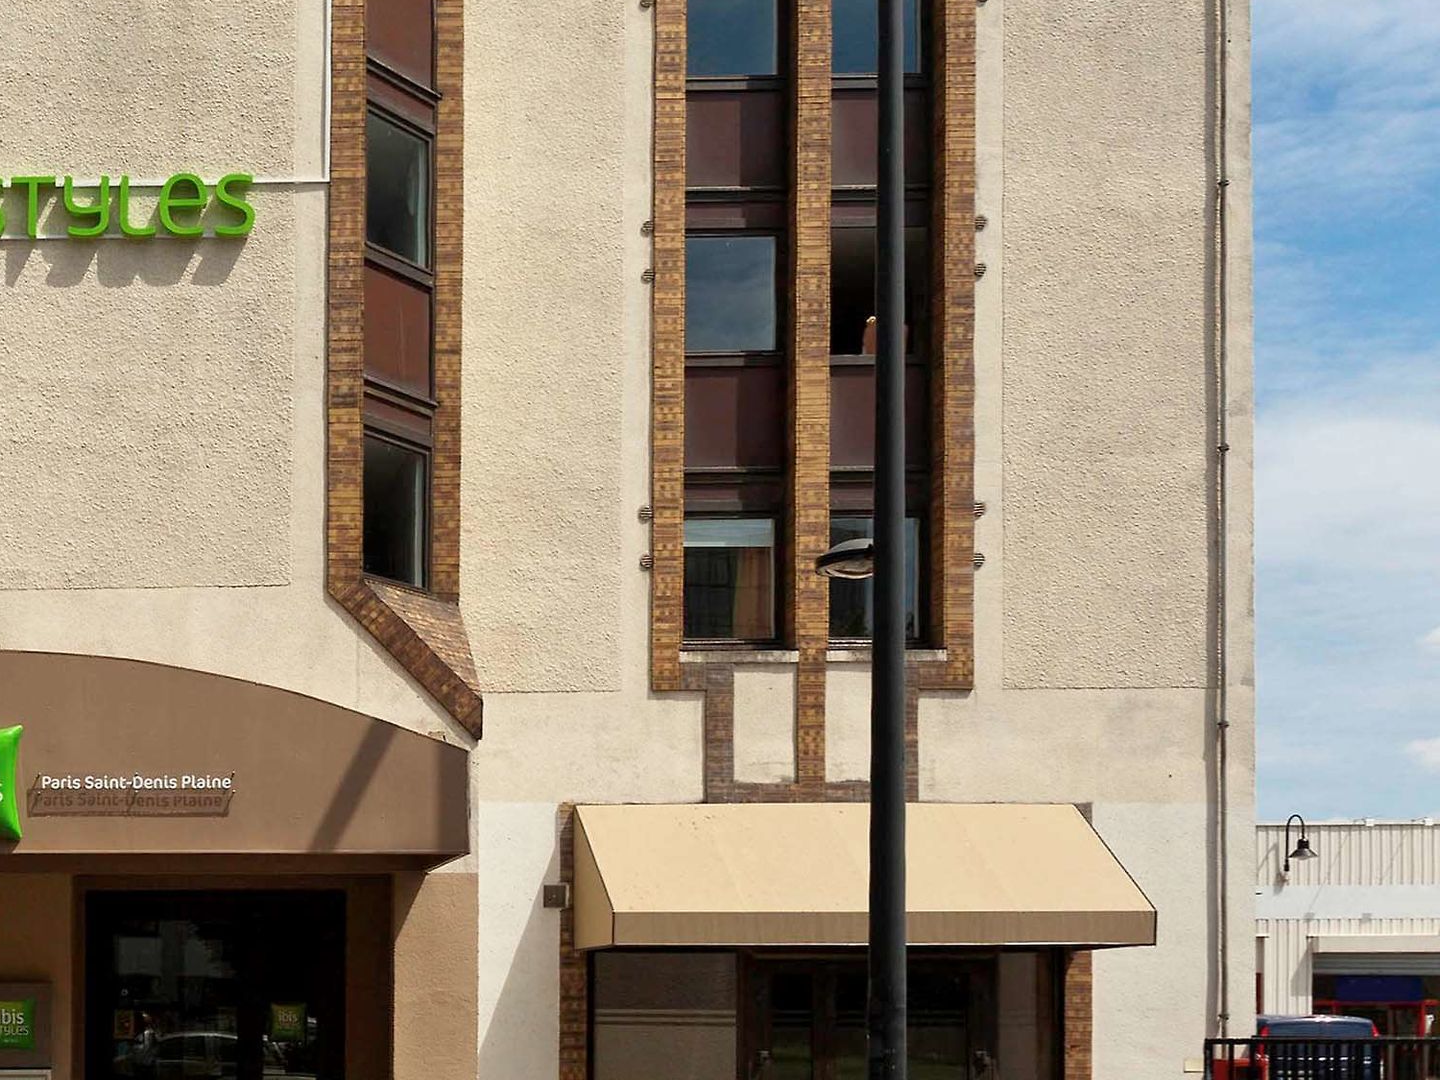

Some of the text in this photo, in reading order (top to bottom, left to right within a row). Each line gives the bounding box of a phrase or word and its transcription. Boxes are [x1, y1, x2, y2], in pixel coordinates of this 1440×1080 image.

[41, 775, 232, 789] Paris Saint-Denis Plaine
